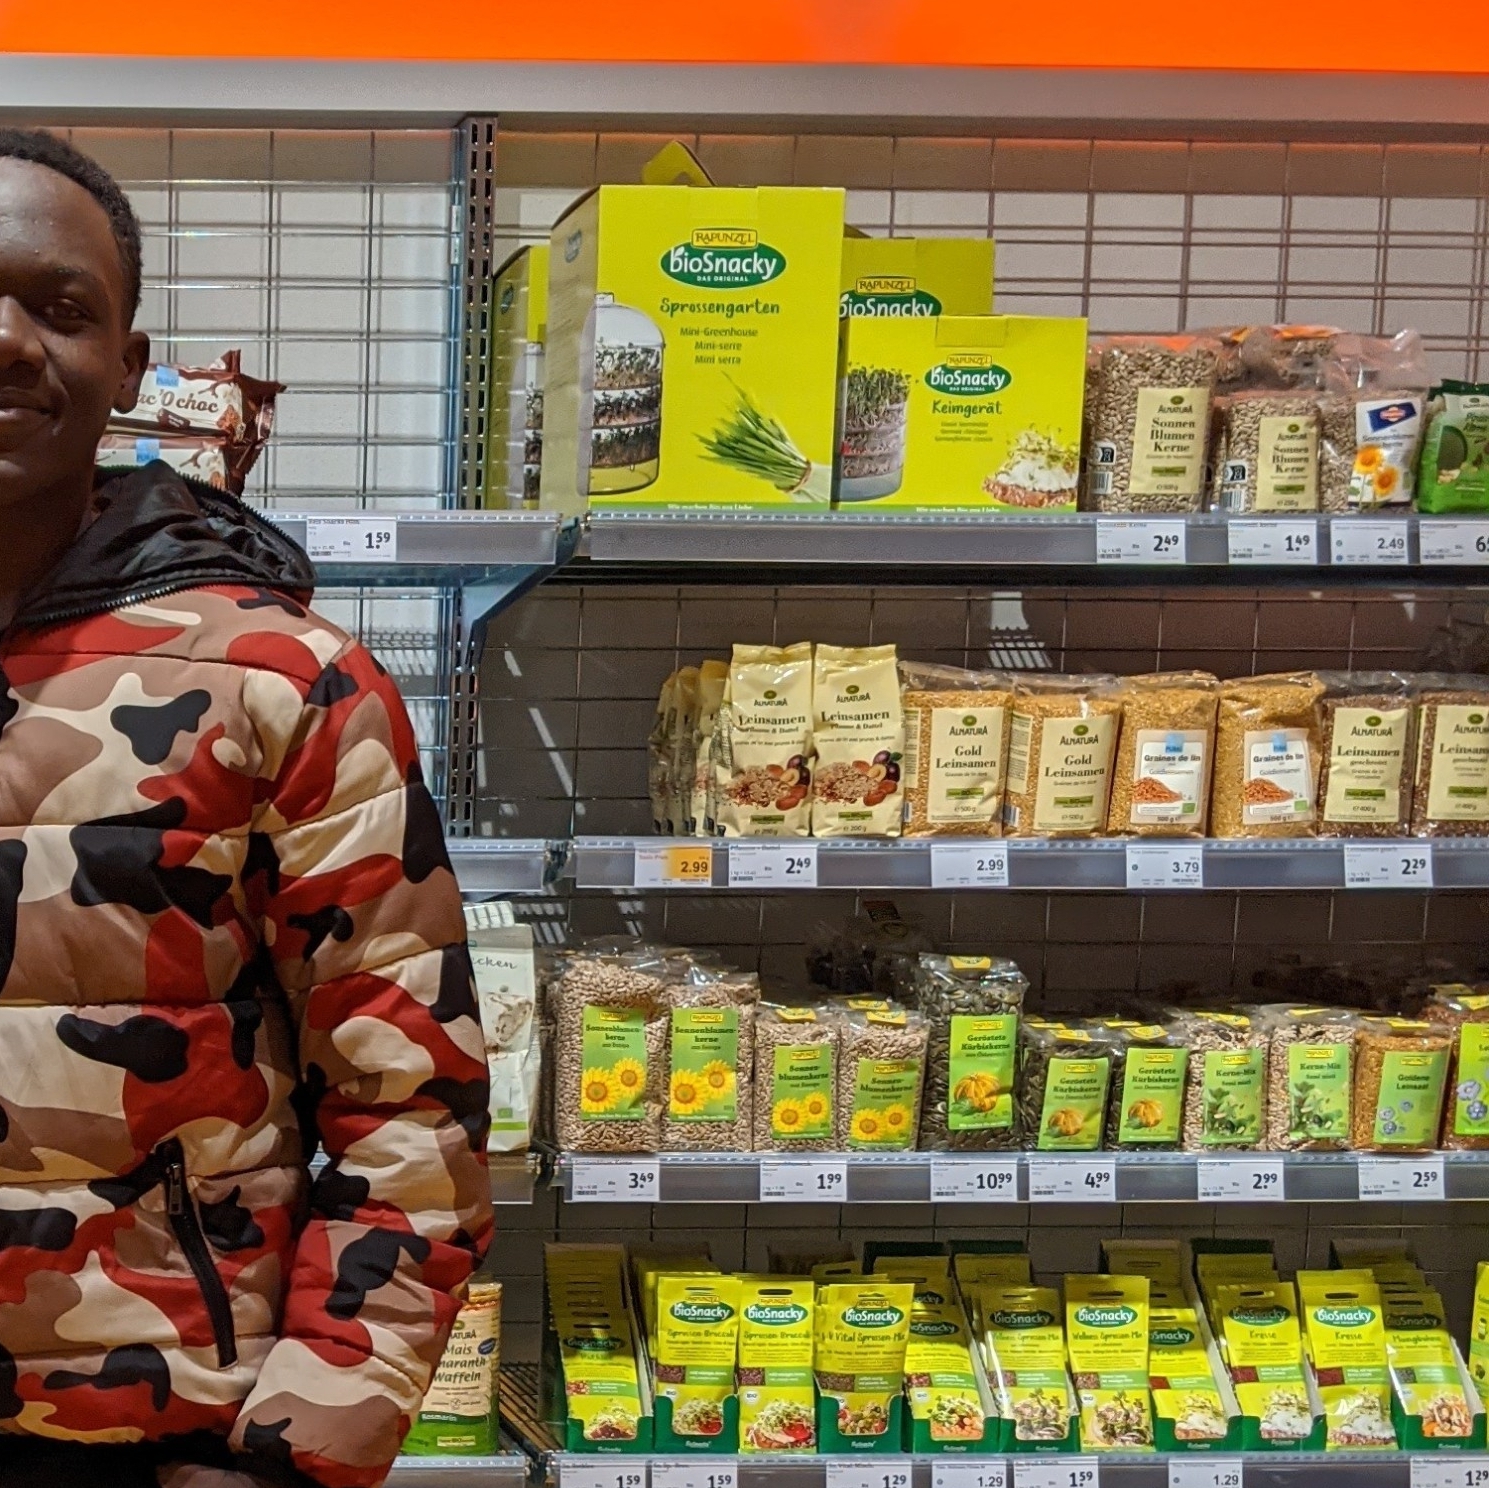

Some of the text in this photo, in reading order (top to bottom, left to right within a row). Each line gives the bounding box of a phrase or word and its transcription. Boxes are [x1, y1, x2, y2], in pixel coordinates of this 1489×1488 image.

[694, 231, 755, 245] RAPUNZEL
[669, 248, 777, 280] bioSnacky
[660, 297, 780, 317] Sprossengarten
[680, 326, 759, 338] Mini-Greenhouse
[930, 366, 1005, 389] bioSnacky
[932, 399, 1002, 417] Keimgerät
[1158, 404, 1193, 414] ALNATURA
[1151, 419, 1196, 429] Sonnen
[1150, 431, 1195, 440] Blumen
[1153, 442, 1190, 453] Kerne
[1377, 538, 1404, 549] 2.49
[949, 725, 988, 735] ALNATURA
[954, 746, 982, 756] Gold
[1337, 746, 1400, 757] Leinsamen
[936, 758, 996, 768] Leinsamen
[1144, 753, 1201, 762] Graines de lin
[680, 861, 708, 873] 2.99
[976, 860, 1003, 871] 2.99
[1172, 861, 1199, 873] 3.79
[673, 1303, 730, 1319] bioSnacky
[1078, 1308, 1134, 1323] bioSnacky
[977, 1476, 1003, 1487] 1.29
[1213, 1475, 1239, 1486] 1.29
